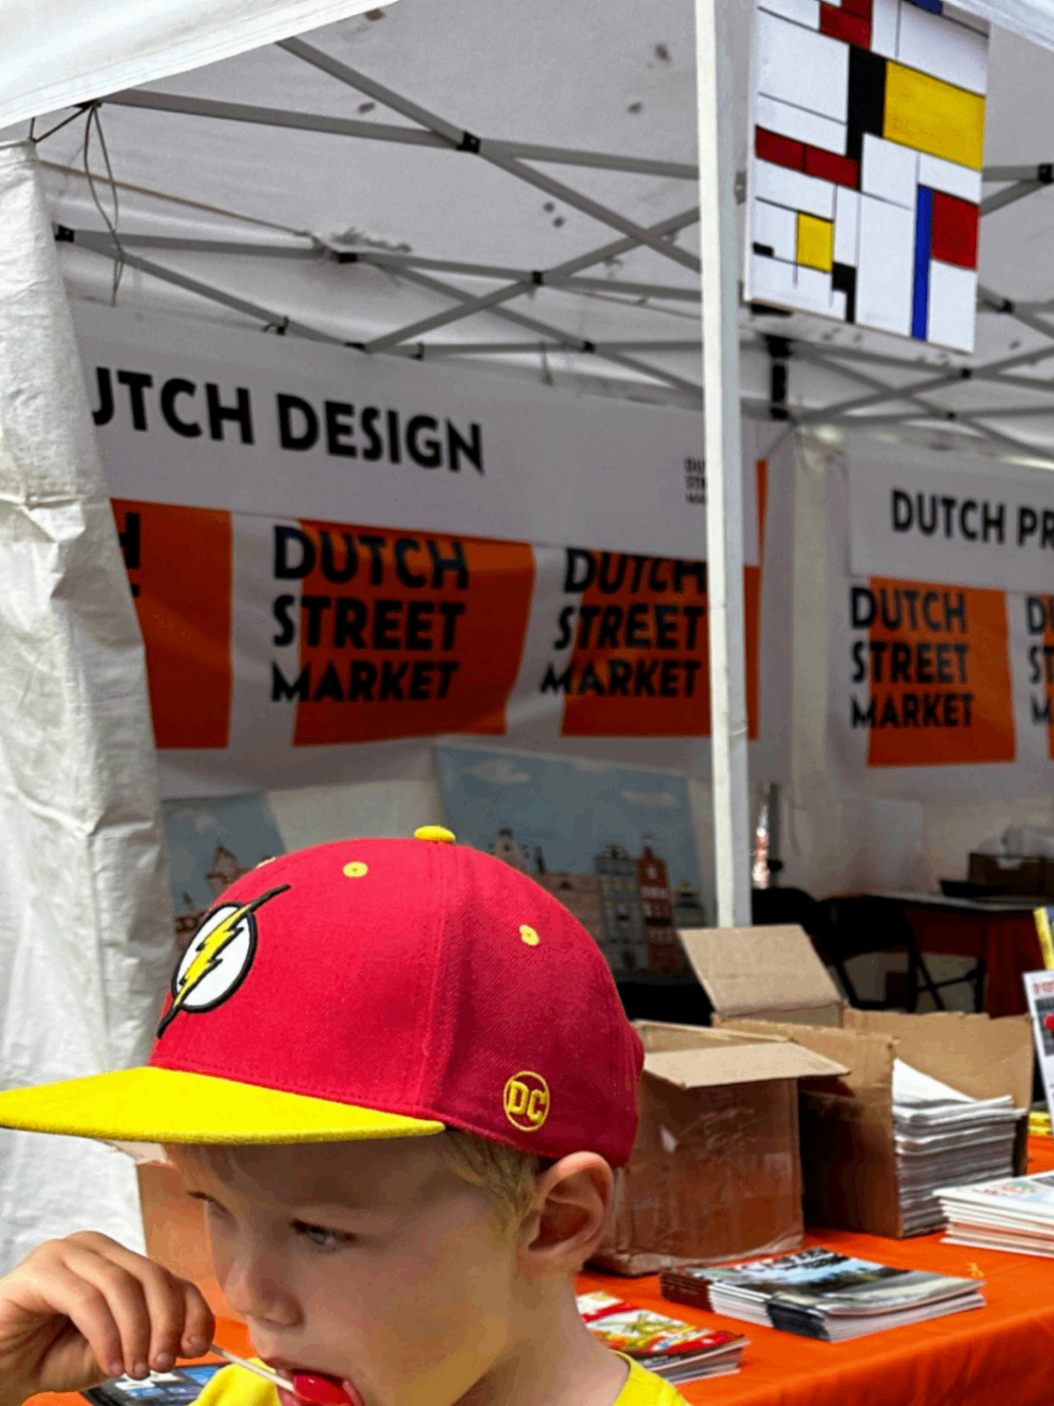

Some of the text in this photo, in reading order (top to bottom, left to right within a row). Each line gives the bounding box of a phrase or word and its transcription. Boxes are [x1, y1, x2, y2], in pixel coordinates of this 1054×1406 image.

[92, 366, 485, 476] UTCH DESIGN
[891, 487, 1006, 545] DUTCH
[273, 525, 469, 590] DUTCH
[564, 547, 707, 594] DUTCH
[273, 594, 466, 651] STREET
[553, 603, 704, 650] STREET
[850, 586, 968, 634] DUTCH
[270, 659, 460, 702] MARKET
[539, 659, 700, 698] MARKET
[851, 640, 969, 685] STREET
[850, 692, 974, 729] MARKET
[507, 1079, 548, 1125] DC
